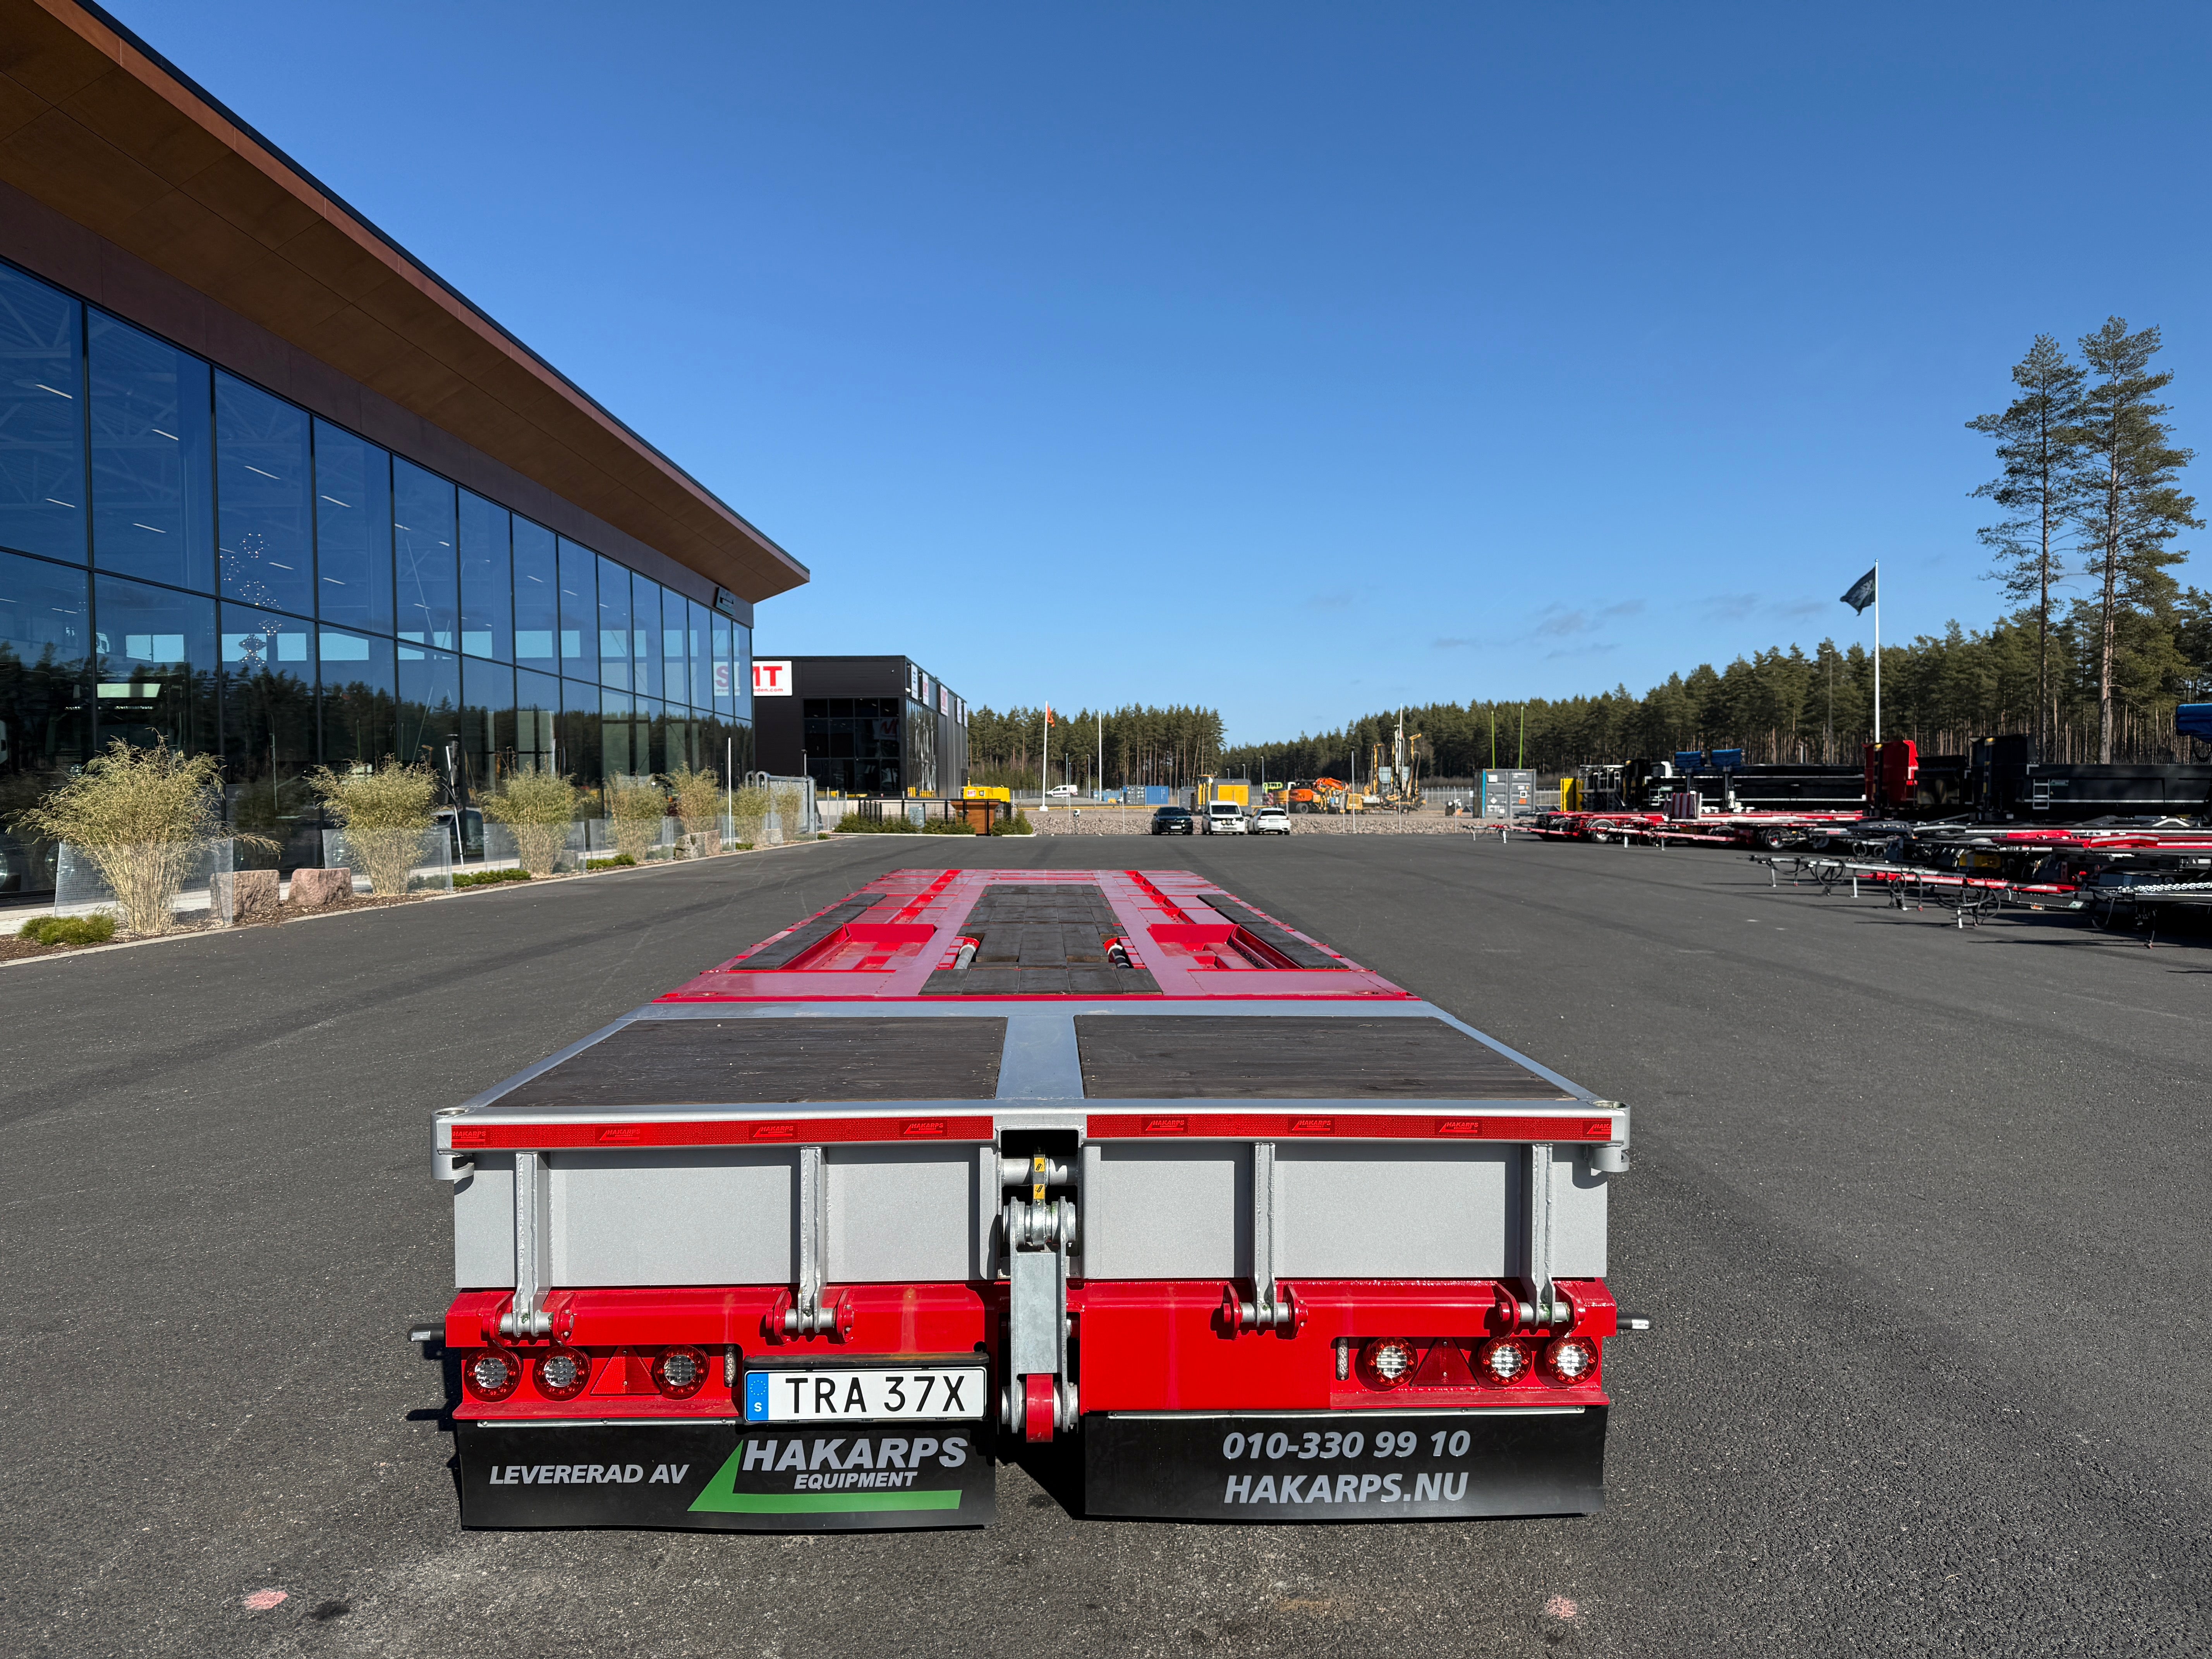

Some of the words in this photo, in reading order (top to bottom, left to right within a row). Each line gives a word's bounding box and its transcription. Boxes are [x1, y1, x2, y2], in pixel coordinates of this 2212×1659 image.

[754, 1402, 762, 1412] S
[785, 1377, 867, 1413] TRA
[884, 1376, 965, 1412] 37X
[742, 1437, 968, 1471] HAKARPS
[1223, 1431, 1364, 1460] 010-330
[1373, 1431, 1417, 1458] 99
[1431, 1430, 1471, 1457] 10
[489, 1464, 644, 1485] LEVERERAD
[648, 1464, 690, 1484] AV
[794, 1471, 918, 1490] EQUIPMENT
[1224, 1472, 1470, 1503] HAKARPS.NU
